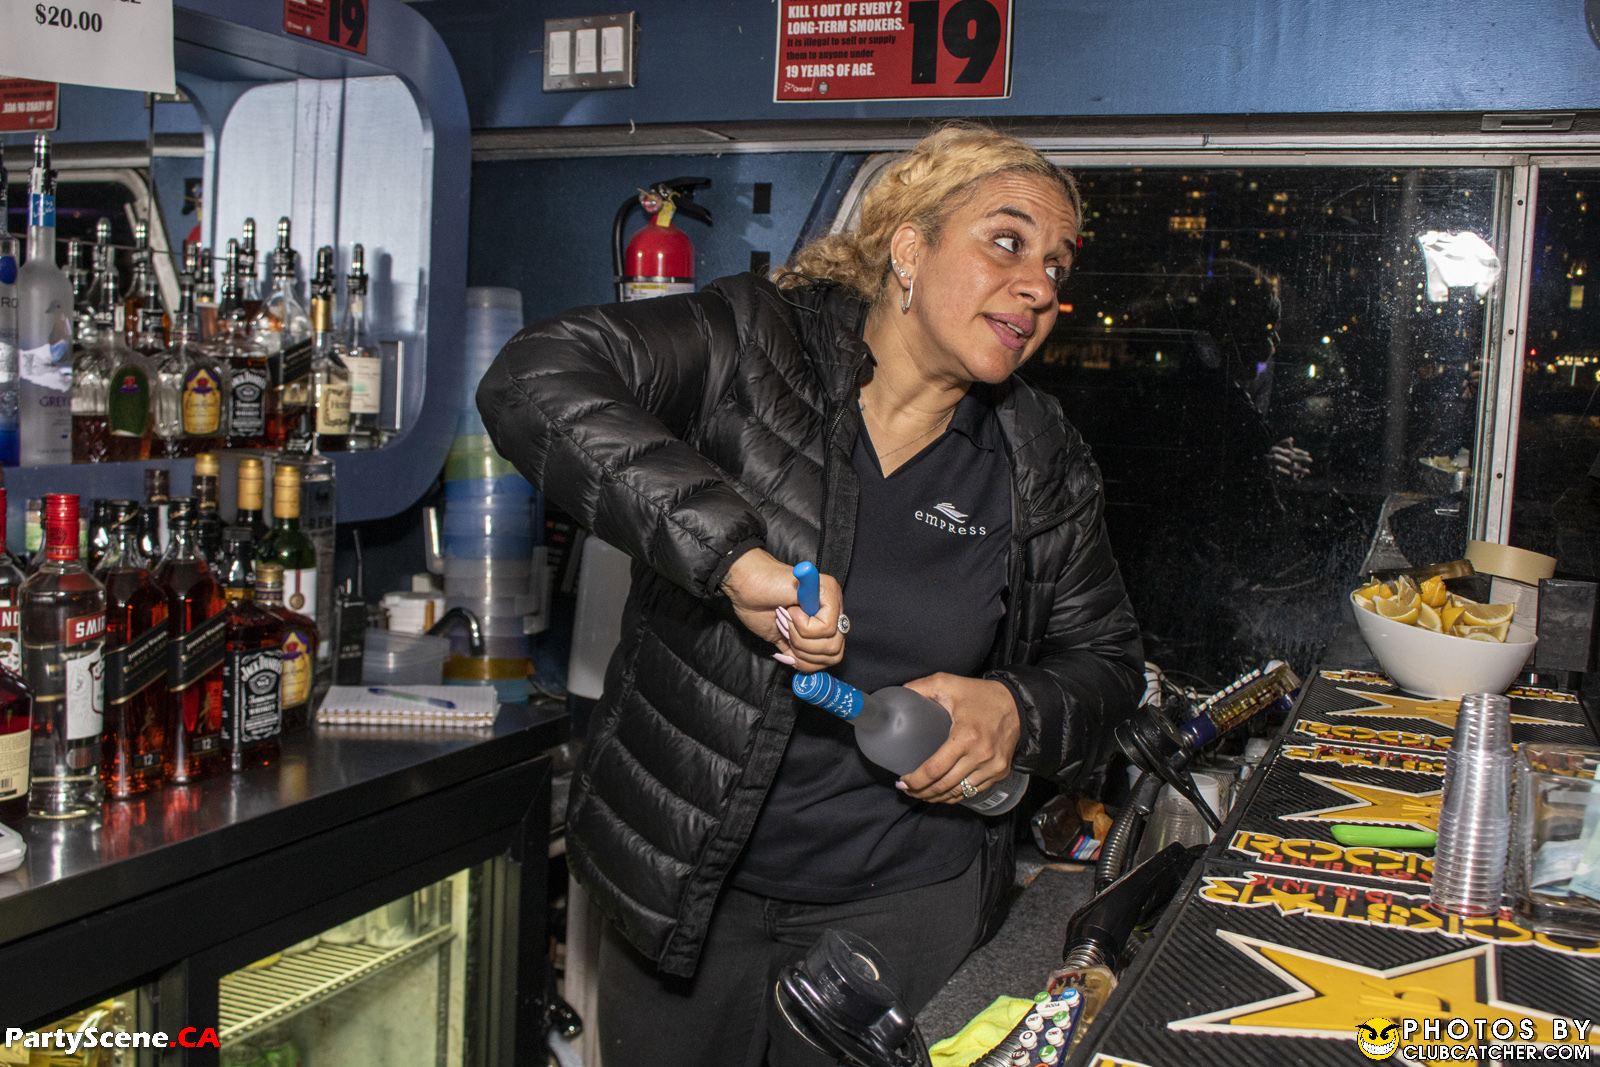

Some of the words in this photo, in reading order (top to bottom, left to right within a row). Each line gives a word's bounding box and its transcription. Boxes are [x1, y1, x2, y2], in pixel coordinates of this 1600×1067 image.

[35, 3, 103, 33] $20.00
[788, 4, 810, 19] KILL
[812, 4, 819, 18] 1
[819, 3, 842, 17] OUT
[843, 2, 858, 16] OF
[859, 1, 892, 16] EVERY
[893, 1, 902, 15] 2
[328, 0, 365, 48] 19
[788, 19, 848, 35] LONG-TERM
[849, 18, 905, 33] SMOKERS.
[831, 37, 840, 46] to
[868, 35, 896, 46] supply
[908, 0, 1001, 84] 19
[786, 51, 808, 60] them
[809, 51, 817, 59] to
[819, 50, 848, 60] anyone
[850, 49, 874, 58] under
[785, 65, 799, 78] 19
[800, 64, 835, 77] YEARS
[836, 63, 851, 77] OF
[851, 62, 876, 76] AGE.
